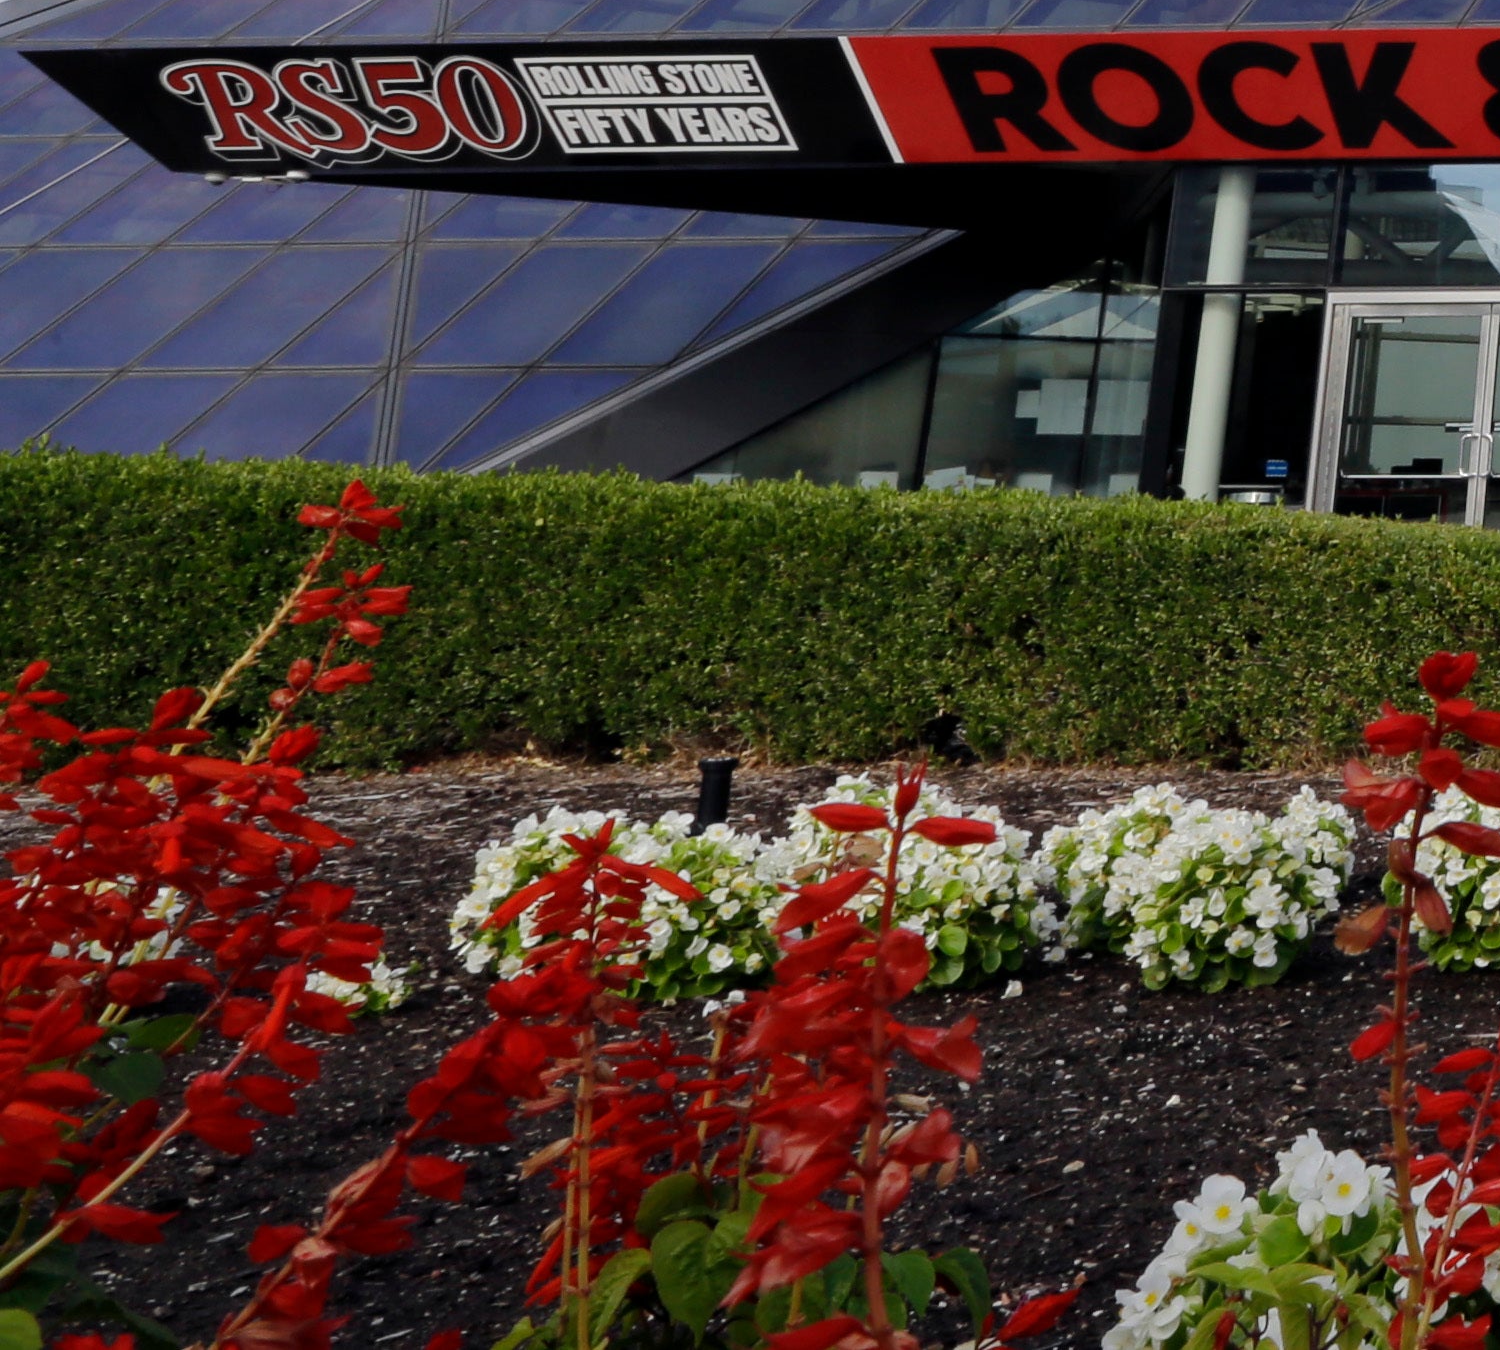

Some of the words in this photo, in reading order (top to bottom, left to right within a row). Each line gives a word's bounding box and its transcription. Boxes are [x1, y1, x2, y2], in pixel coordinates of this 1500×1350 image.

[160, 55, 540, 166] RS50
[528, 64, 661, 97] ROLLING
[657, 62, 761, 94] STONE
[932, 40, 1455, 153] ROCK
[552, 107, 656, 145] FIFTY
[654, 106, 781, 143] YEARS
